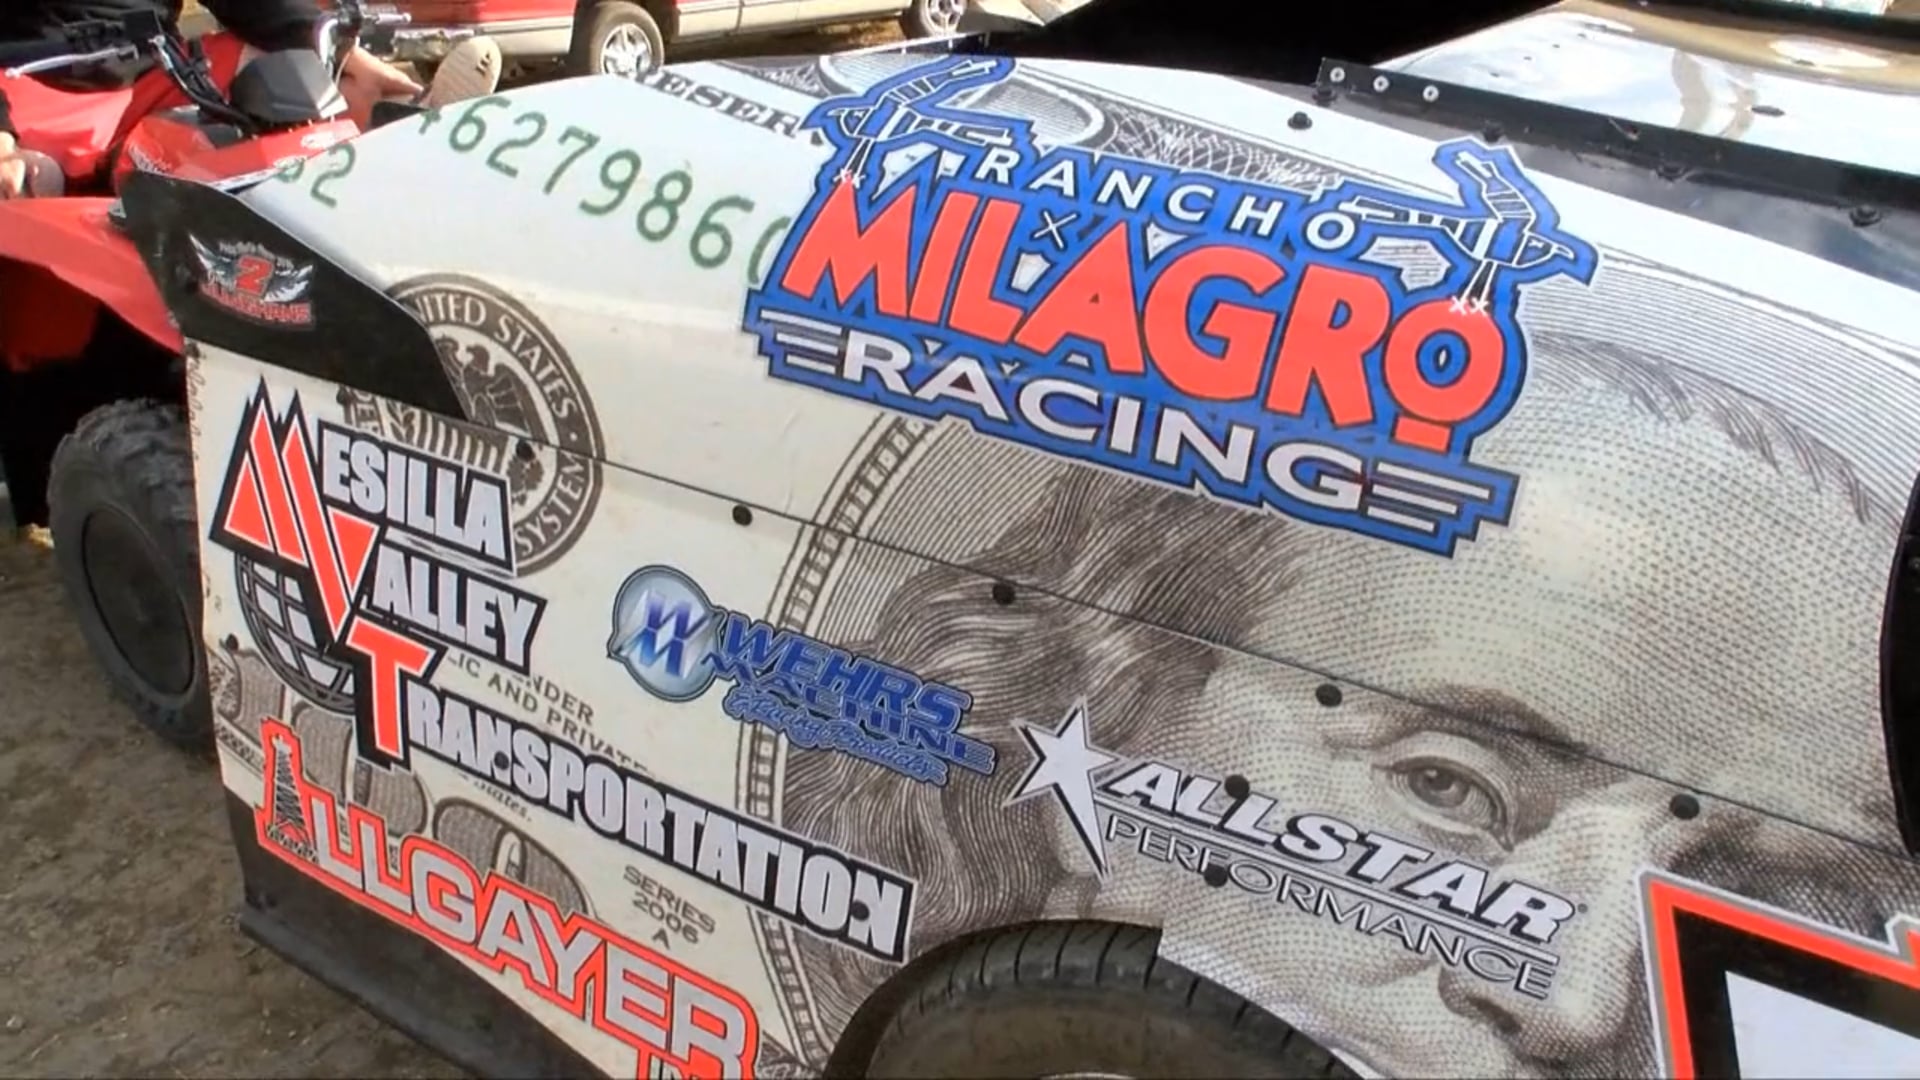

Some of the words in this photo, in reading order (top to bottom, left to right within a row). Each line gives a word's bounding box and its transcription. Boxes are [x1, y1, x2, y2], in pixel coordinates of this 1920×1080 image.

[980, 147, 1358, 252] RANCHO
[235, 255, 275, 296] 2
[781, 166, 1506, 455] MILAGRO
[493, 314, 580, 419] STATES
[840, 330, 1368, 514] RACING
[513, 450, 586, 556] SYSTEM
[487, 671, 539, 714] AND
[722, 612, 974, 736] WEHRS
[623, 863, 717, 935] SERIES
[1104, 762, 1575, 945] ALLSTAR
[1105, 812, 1556, 999] PERFORMANCE
[631, 890, 700, 945] 2006
[651, 927, 671, 950] A
